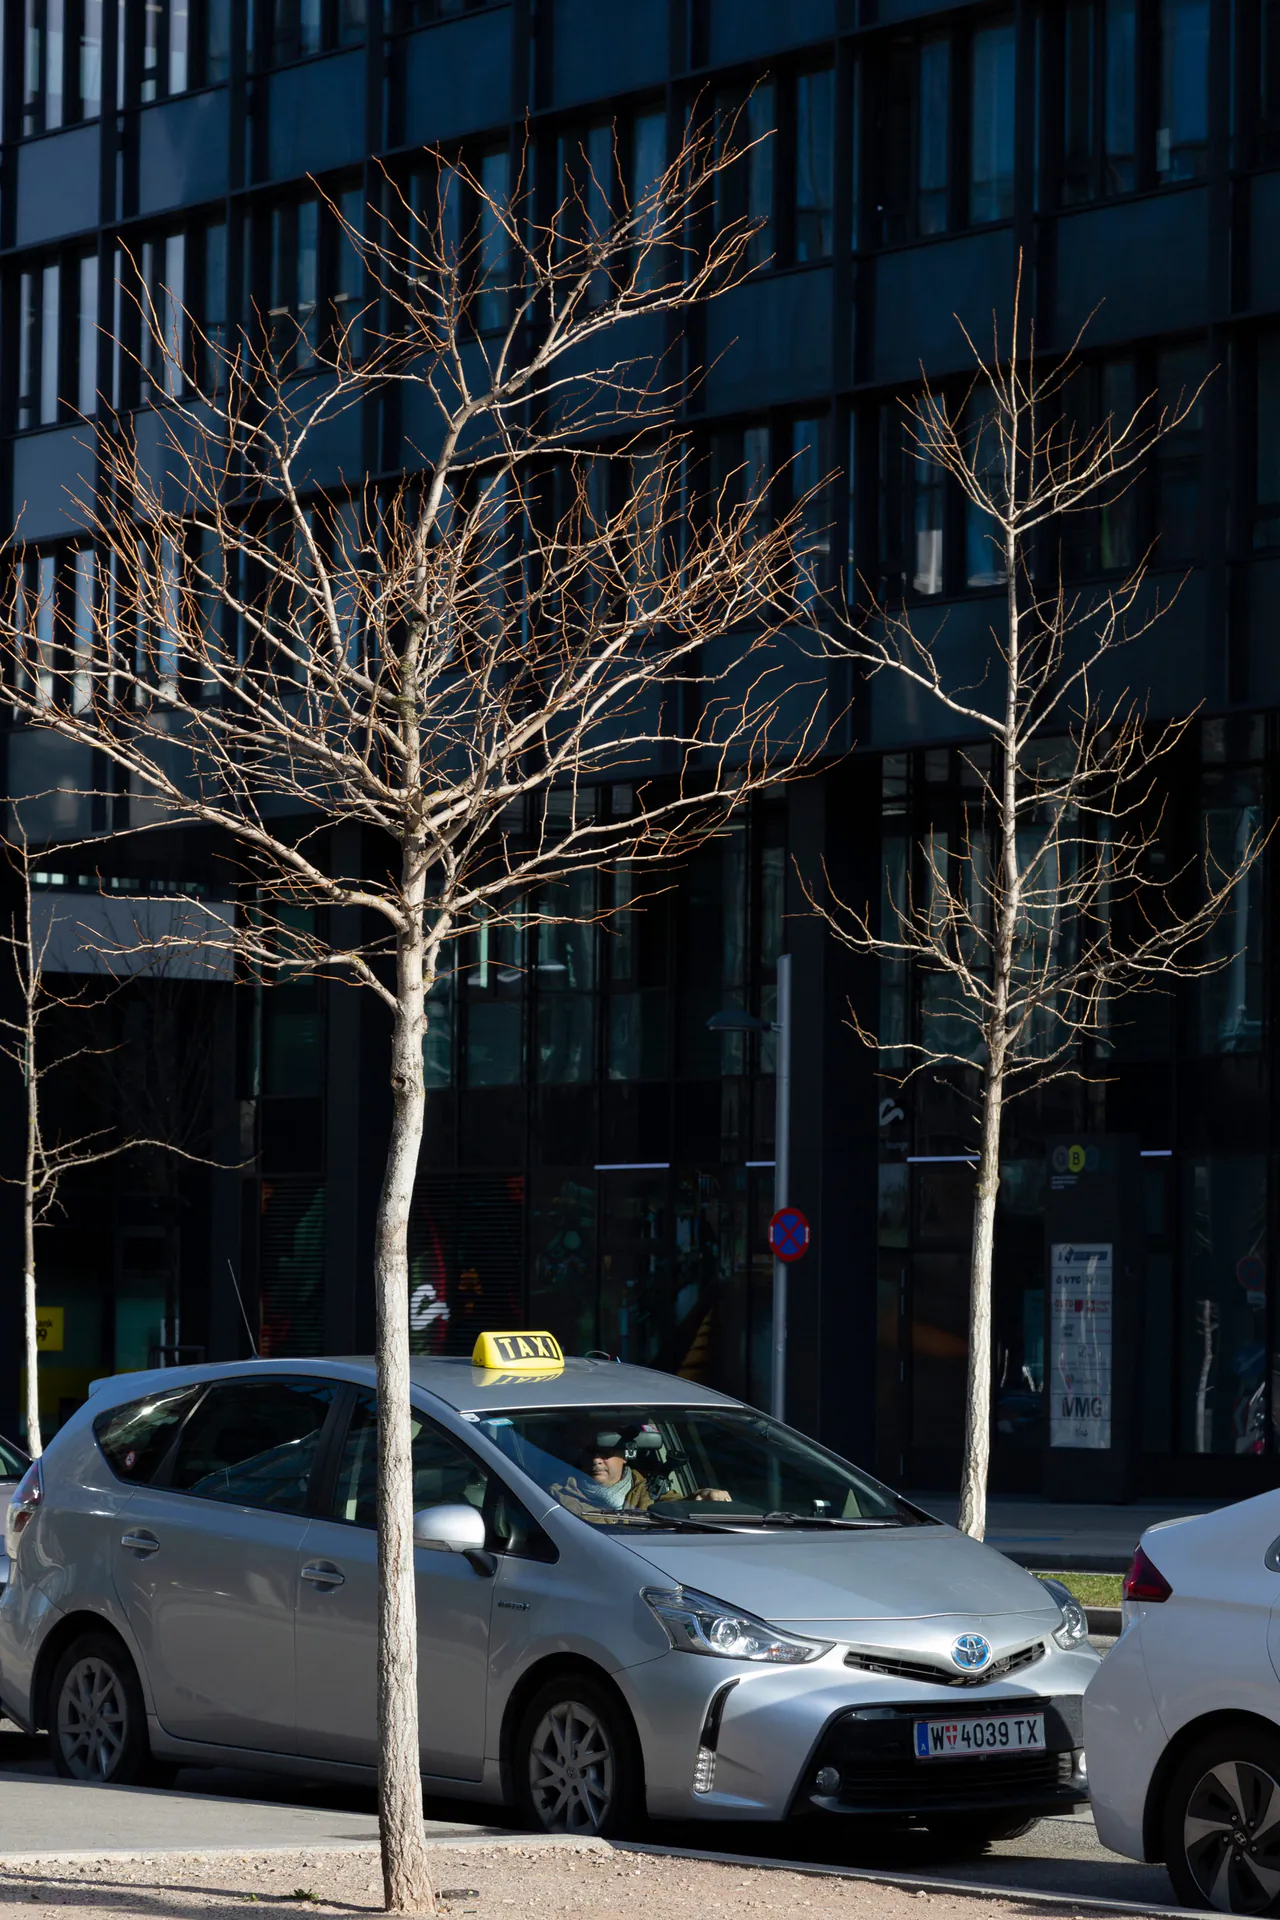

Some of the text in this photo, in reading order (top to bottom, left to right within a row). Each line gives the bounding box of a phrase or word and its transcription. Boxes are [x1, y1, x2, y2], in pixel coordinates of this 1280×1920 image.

[498, 1336, 558, 1359] TAXI
[931, 1719, 1038, 1751] W 4039 TX
